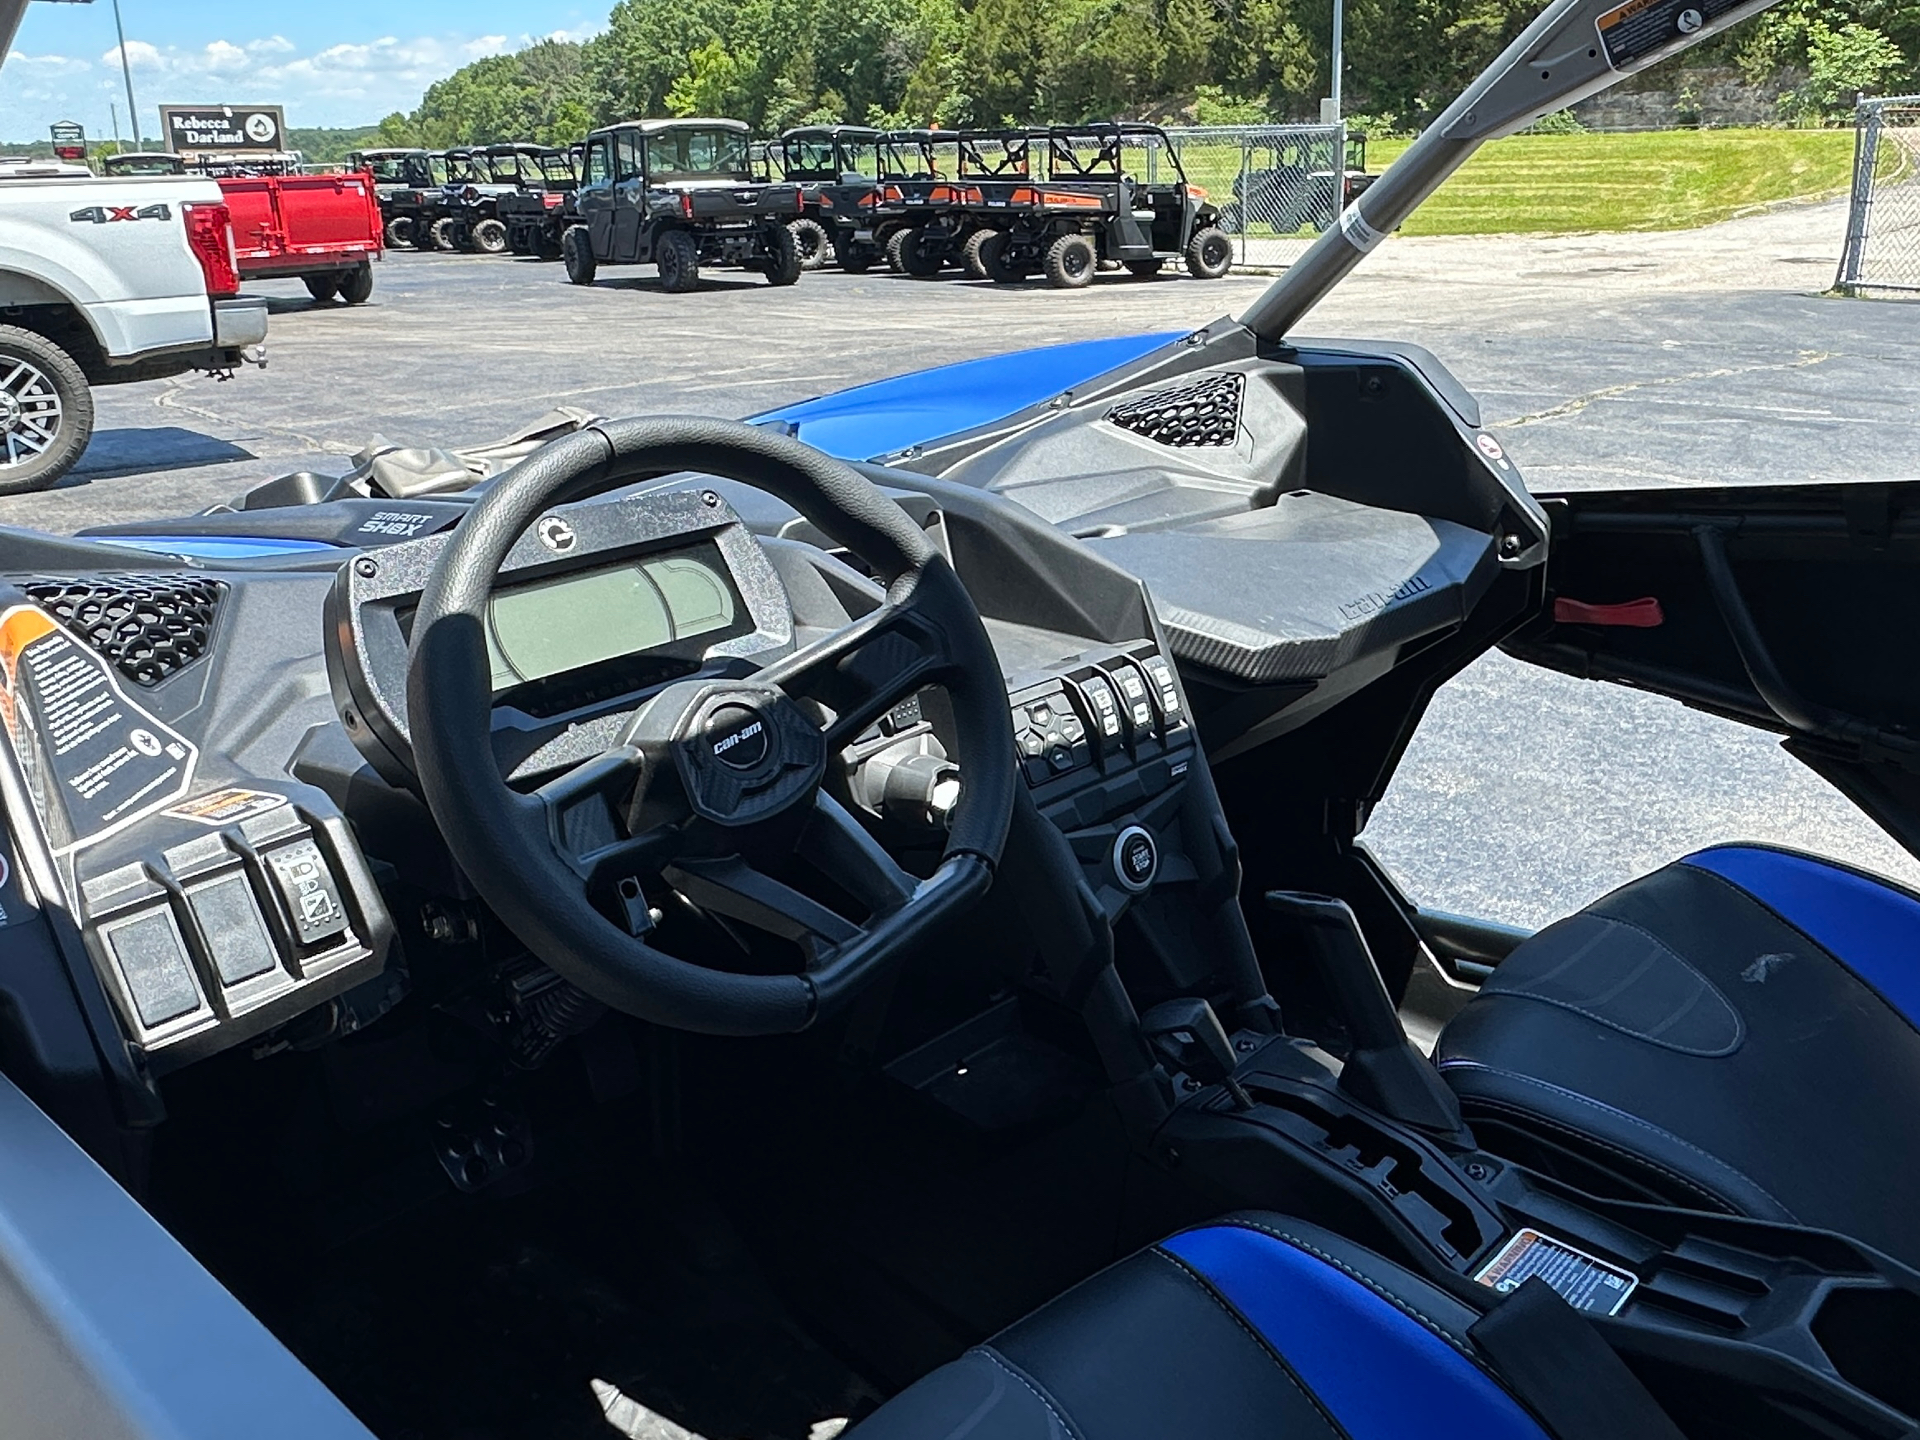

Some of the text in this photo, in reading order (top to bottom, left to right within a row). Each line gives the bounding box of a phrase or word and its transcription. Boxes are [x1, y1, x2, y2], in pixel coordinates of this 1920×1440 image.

[172, 116, 230, 129] Rebecca
[185, 130, 244, 143] Darland
[370, 511, 433, 524] SMART
[713, 721, 762, 755] can-am
[1491, 1238, 1532, 1276] WARNING
